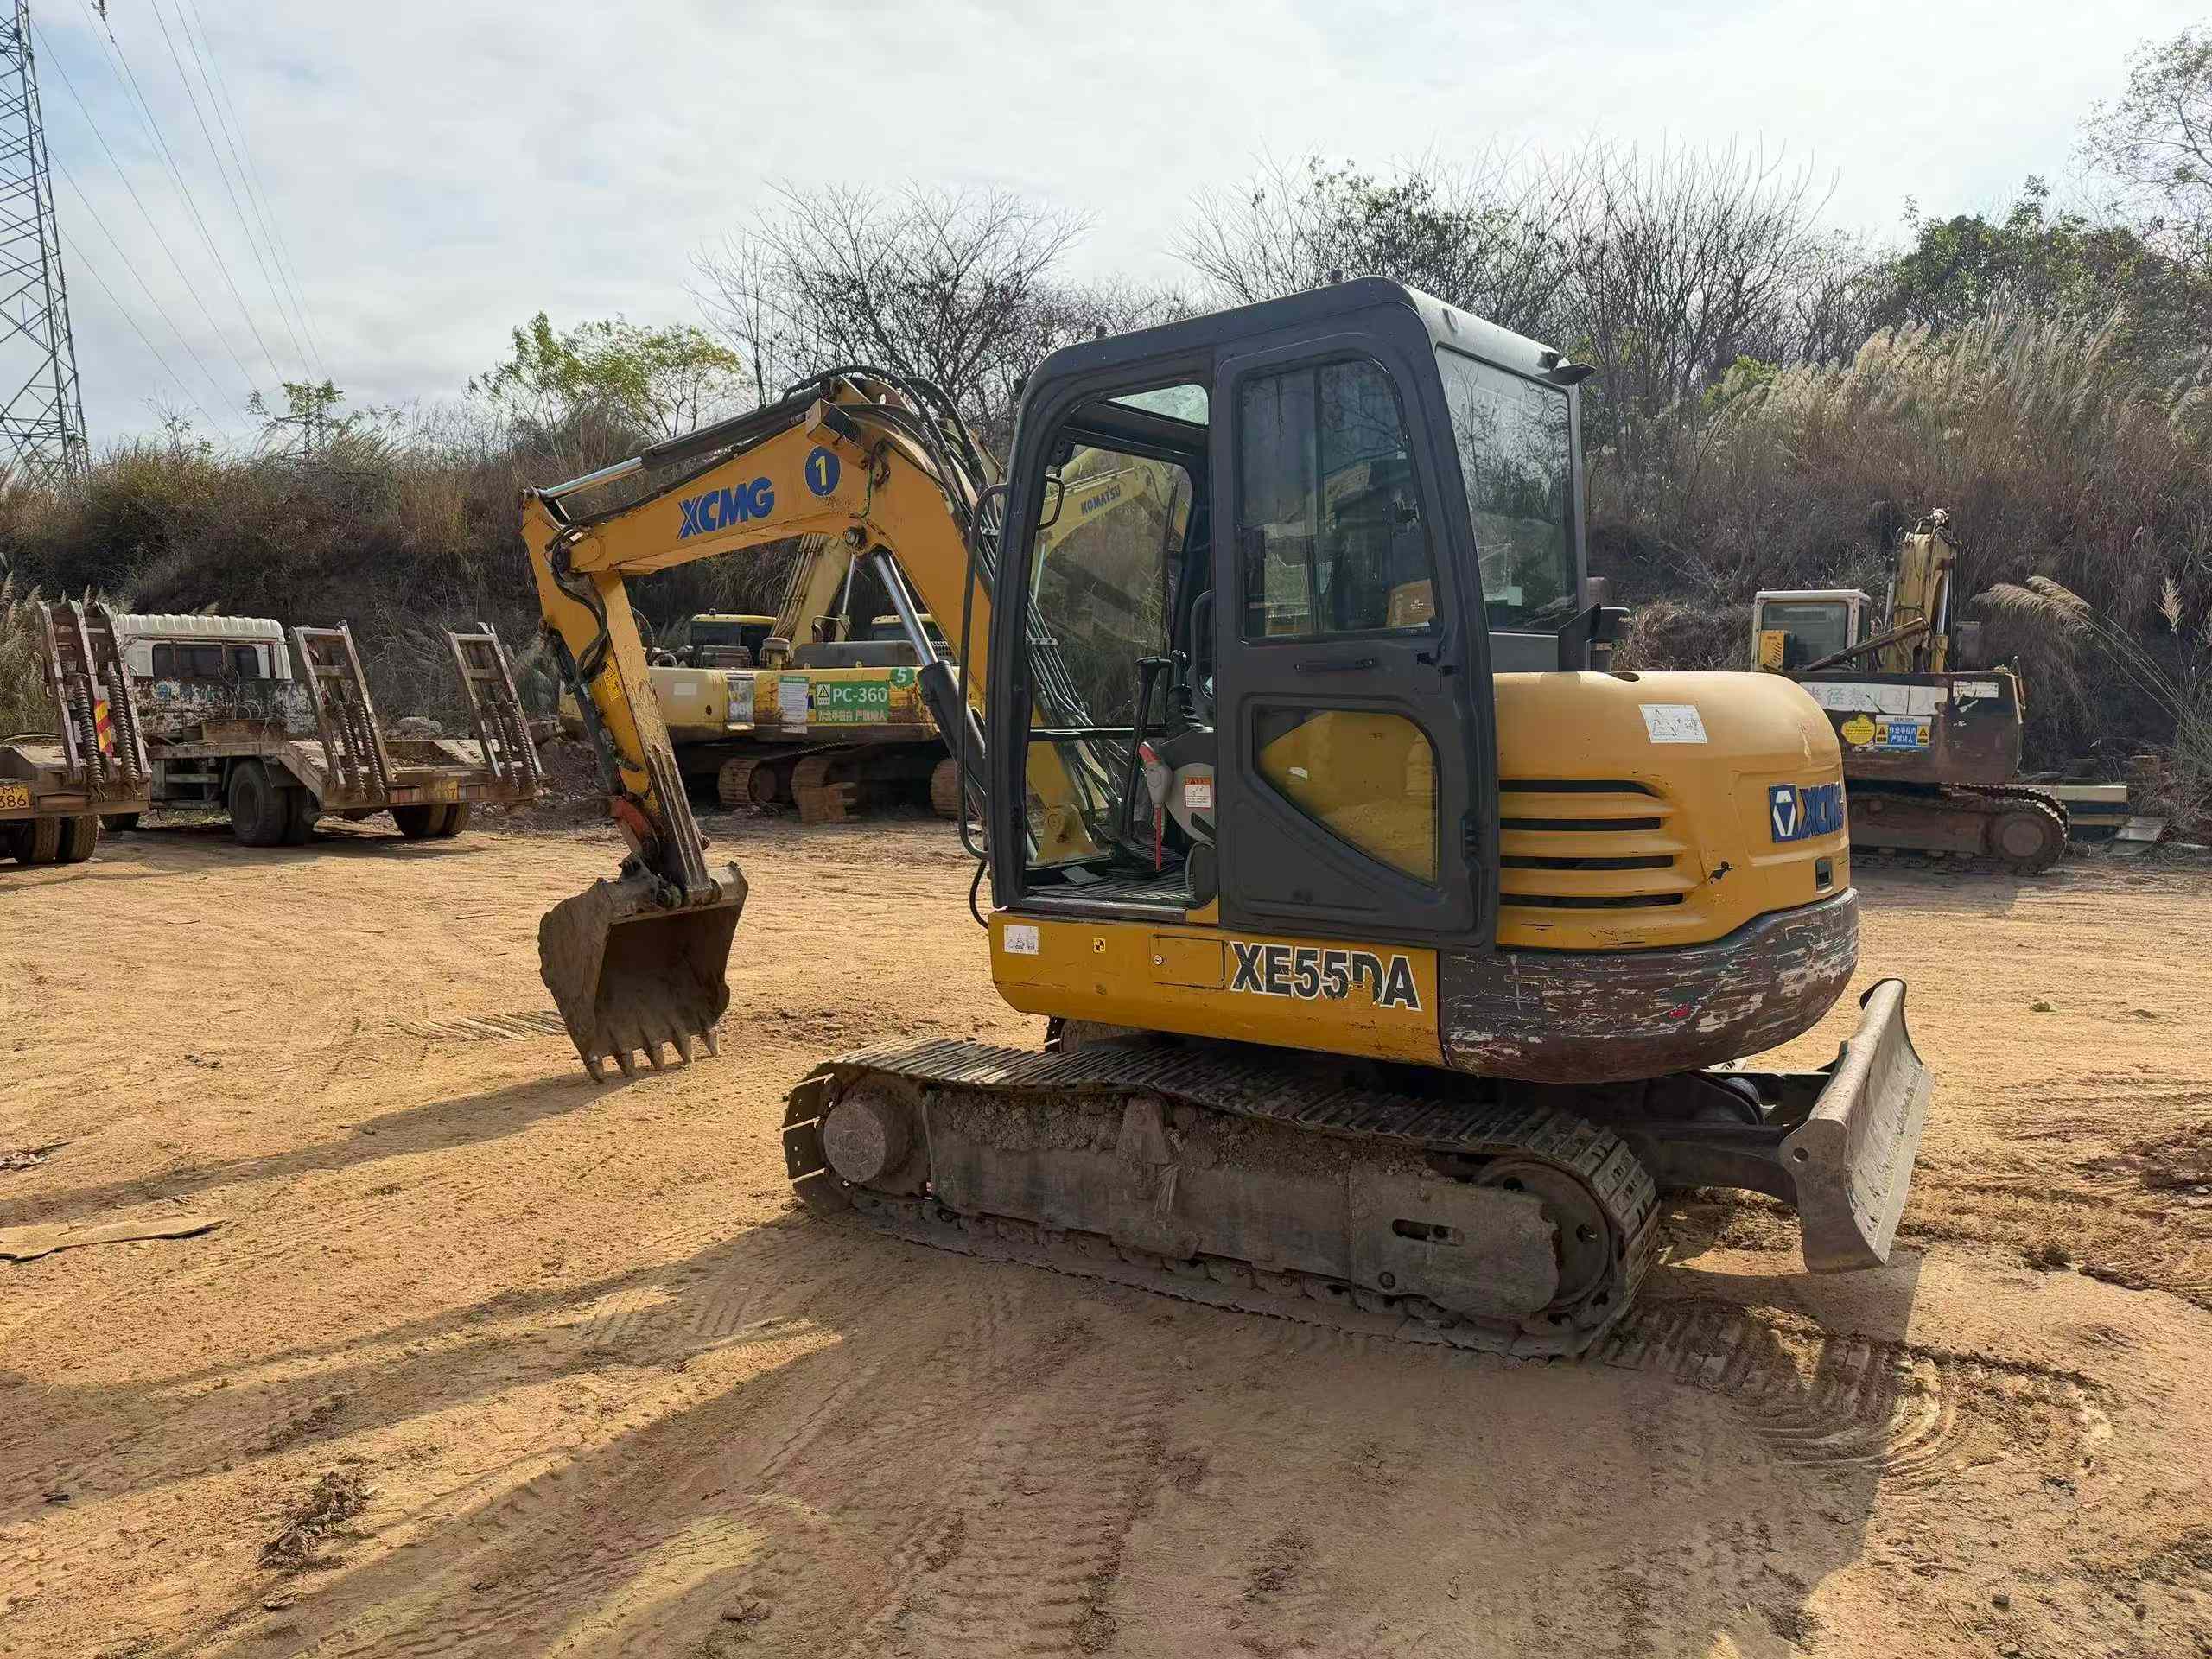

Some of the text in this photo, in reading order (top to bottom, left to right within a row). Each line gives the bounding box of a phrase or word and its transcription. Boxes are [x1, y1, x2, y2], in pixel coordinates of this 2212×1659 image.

[815, 455, 829, 486] 1
[677, 476, 775, 540] XCMG
[1080, 483, 1121, 517] KOMATSU
[897, 667, 907, 683] 5
[832, 687, 888, 703] PC-360
[1230, 940, 1424, 1012] XE55DA
